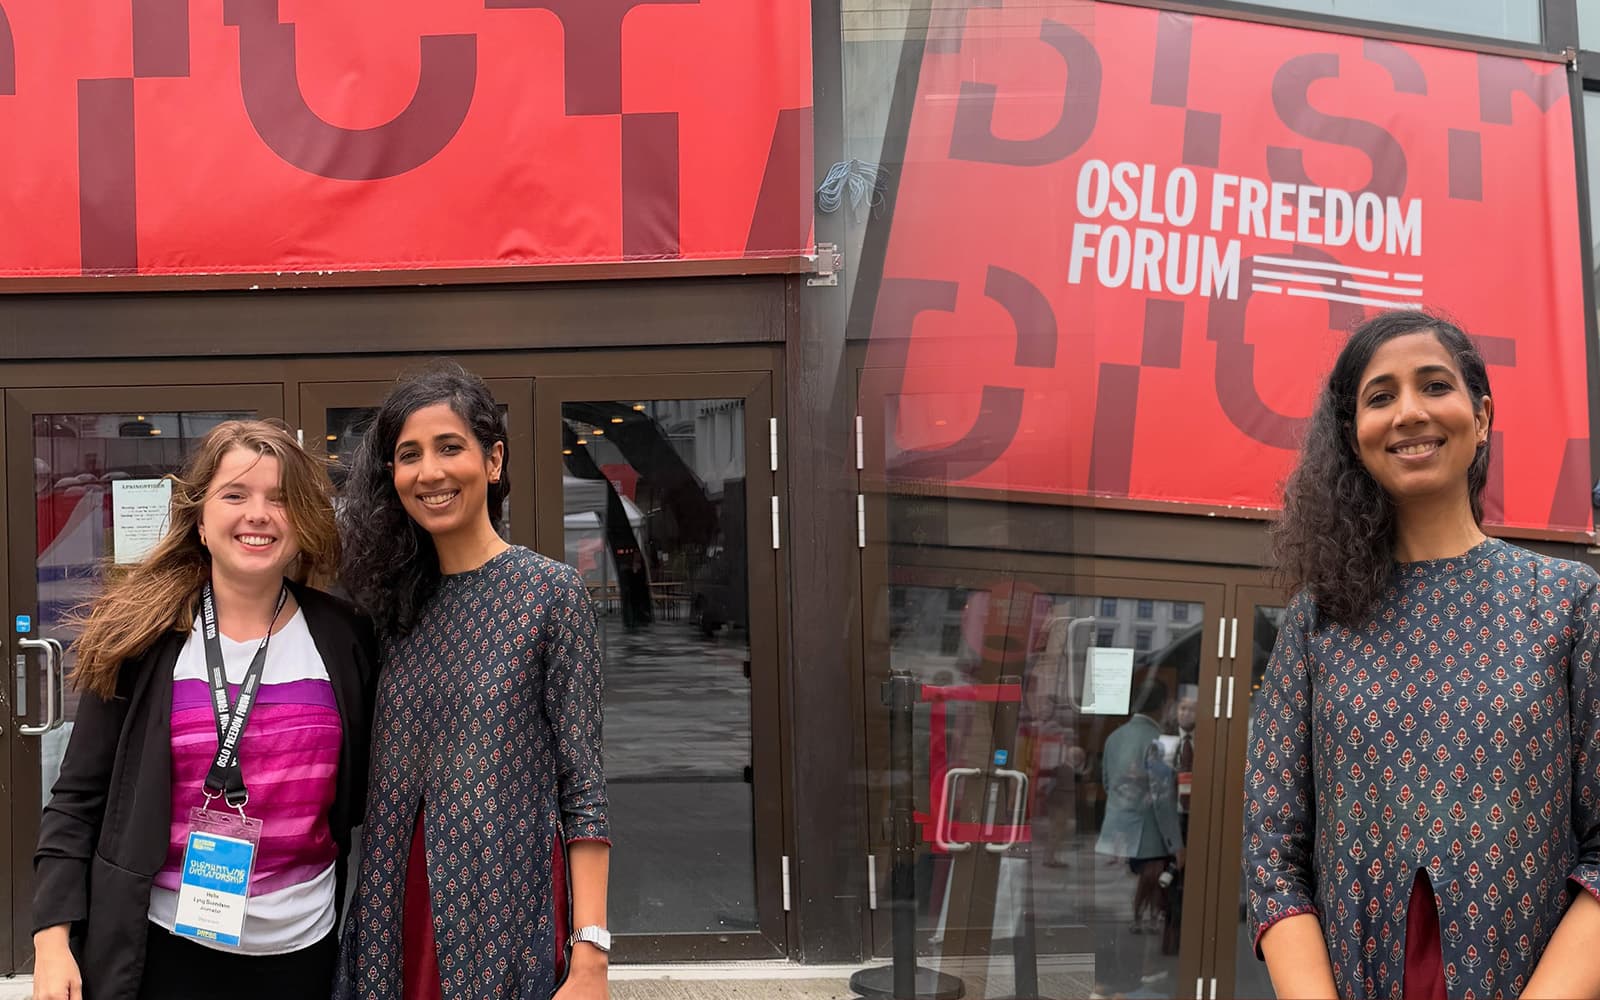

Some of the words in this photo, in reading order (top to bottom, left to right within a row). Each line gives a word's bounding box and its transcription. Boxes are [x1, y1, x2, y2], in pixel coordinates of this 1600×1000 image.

[1076, 159, 1197, 227] OSLO
[1211, 173, 1422, 256] FREEDOM
[1068, 223, 1241, 300] FORUM
[206, 623, 216, 639] OSLO
[215, 689, 228, 713] FORUM
[235, 693, 251, 717] FORUM
[223, 715, 244, 749] FREEDOM
[216, 748, 232, 768] OSLO
